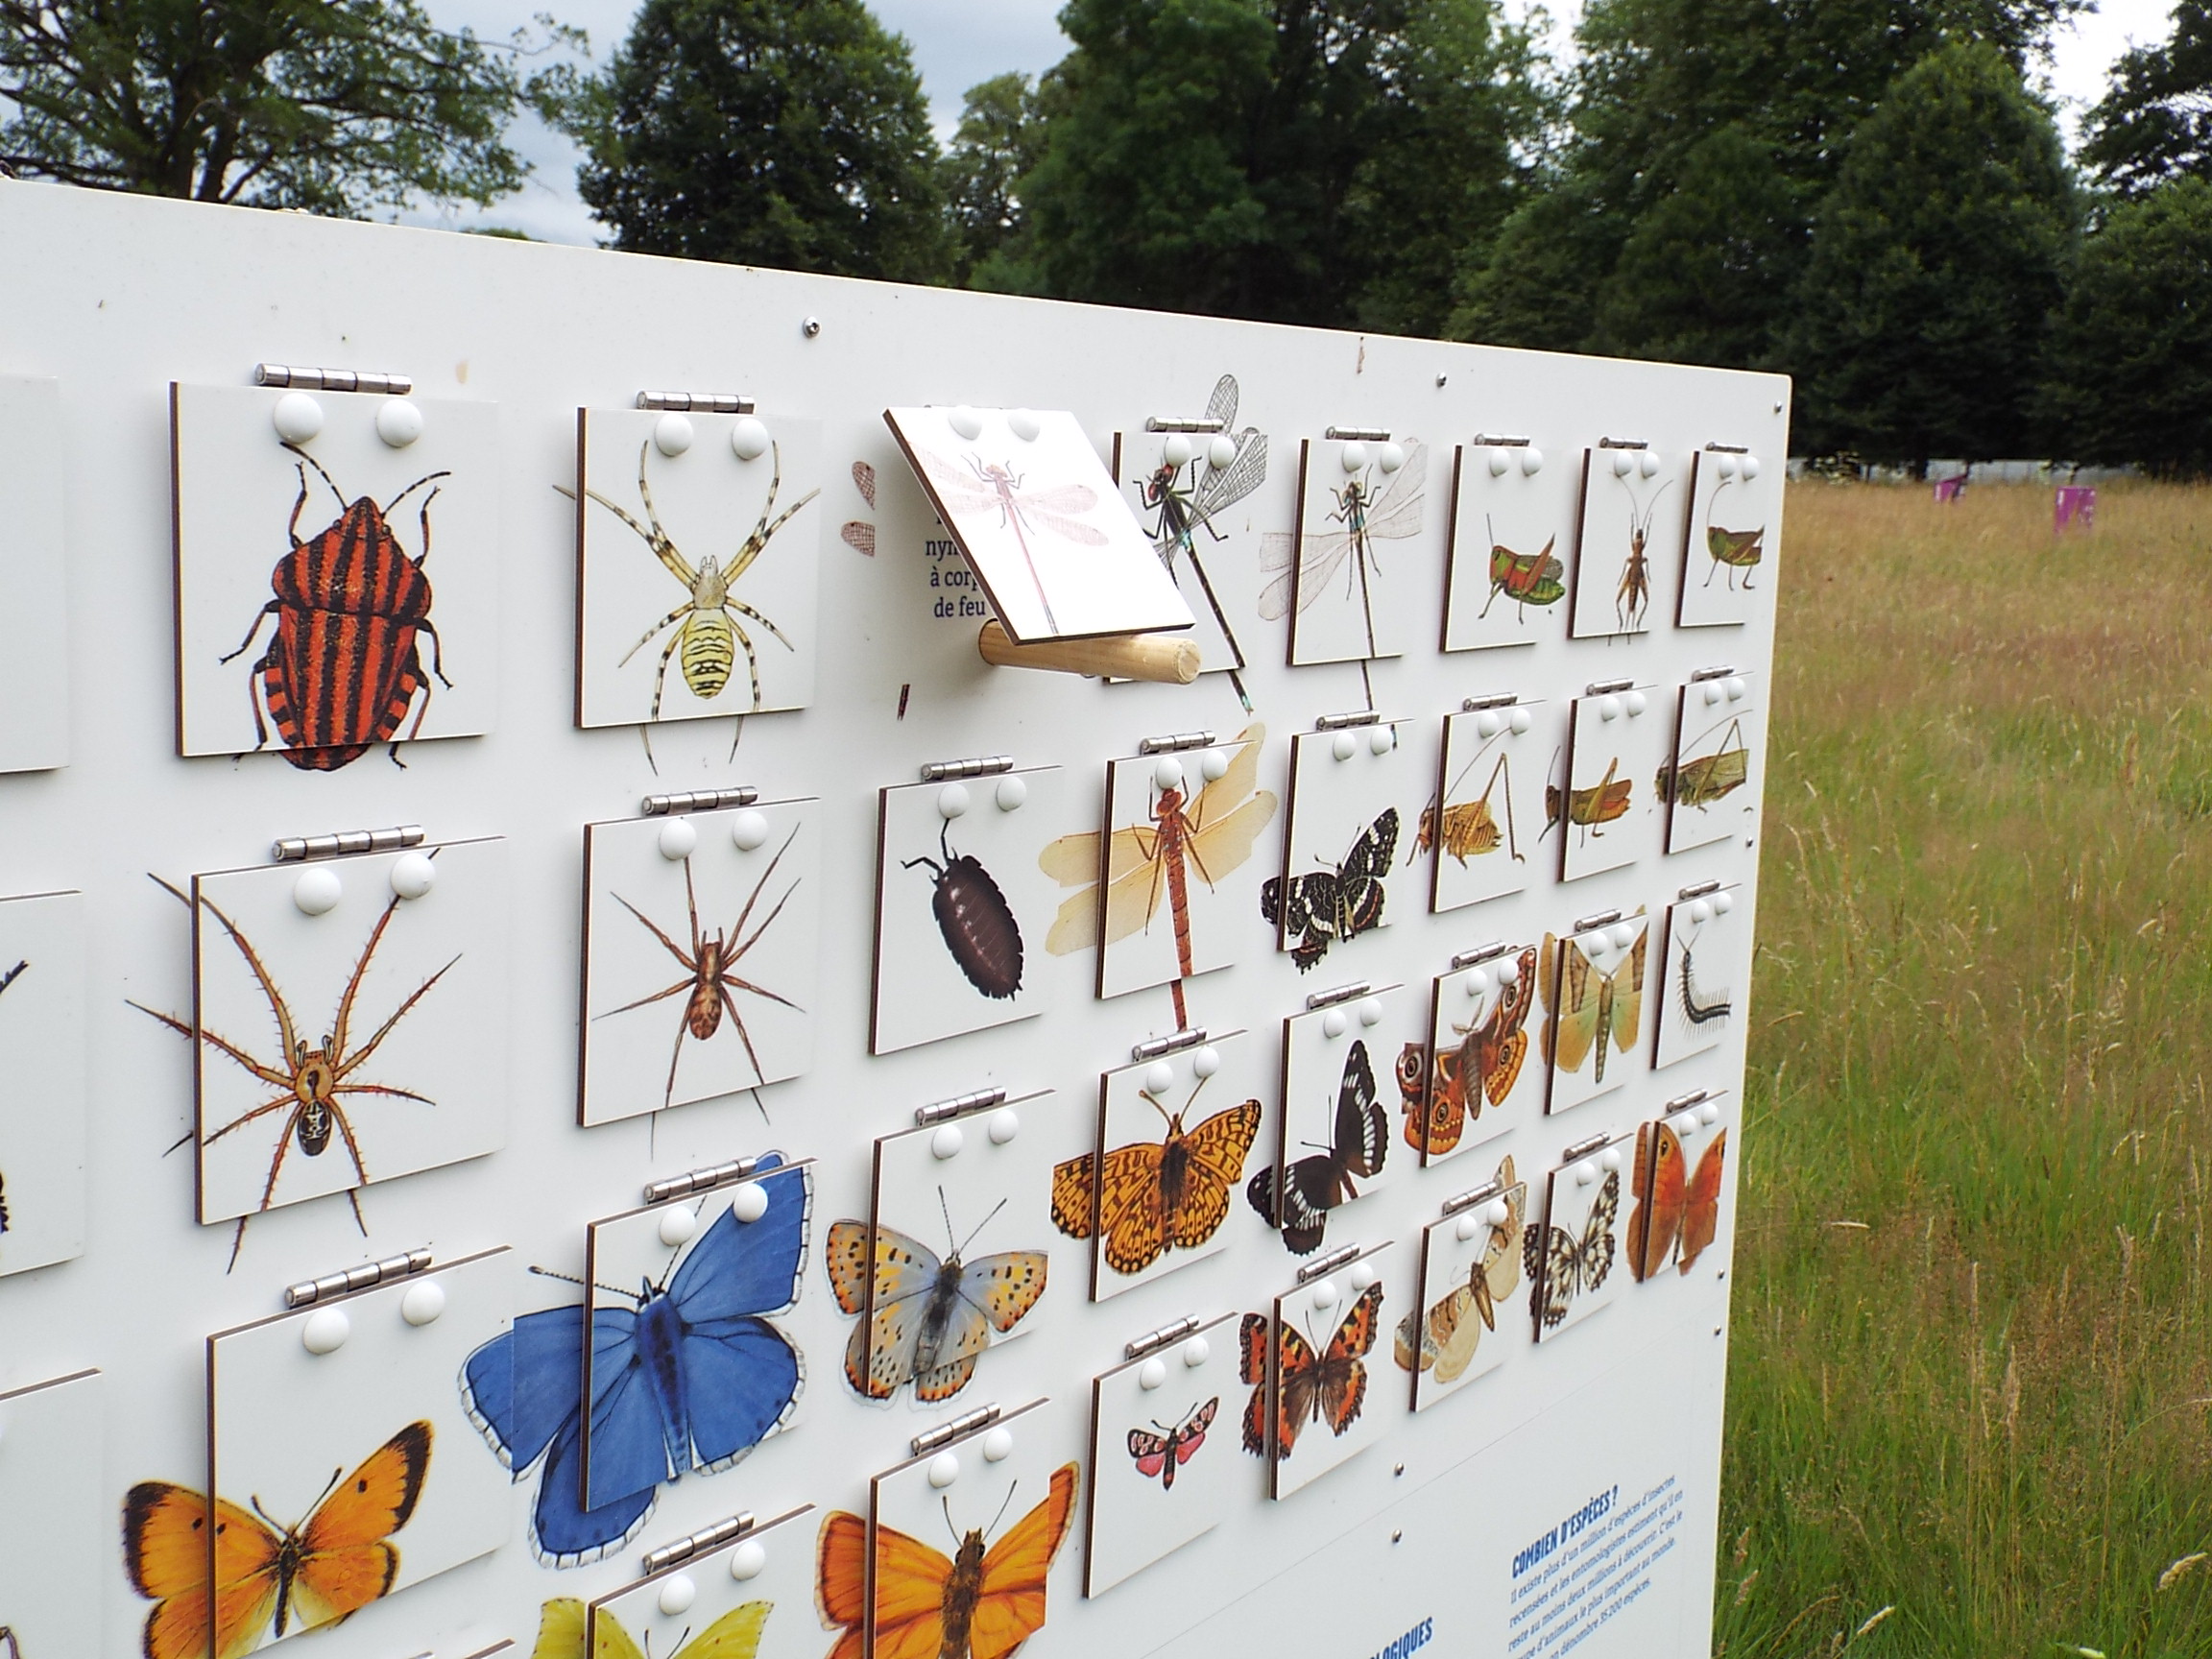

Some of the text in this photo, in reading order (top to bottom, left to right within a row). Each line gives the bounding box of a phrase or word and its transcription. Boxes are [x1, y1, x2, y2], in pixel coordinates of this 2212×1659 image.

[926, 540, 959, 562] nym
[930, 565, 976, 590] à cor
[934, 595, 986, 617] de feu
[1512, 1527, 1557, 1578] COMBIEN
[1561, 1490, 1610, 1545] D'ESPÈCES
[1511, 1589, 1517, 1604] Il
[1518, 1575, 1542, 1599] existe
[1543, 1562, 1560, 1583] plus
[1561, 1548, 1578, 1567] d'un
[1580, 1527, 1606, 1552] million
[1551, 1583, 1558, 1597] et
[1559, 1575, 1570, 1590] les
[1587, 1594, 1603, 1616] plus
[1508, 1629, 1528, 1651] reste
[1530, 1621, 1541, 1635] au
[1542, 1600, 1566, 1626] moins
[1568, 1586, 1586, 1606] deux
[1370, 1616, 1432, 1659] OGIQUES
